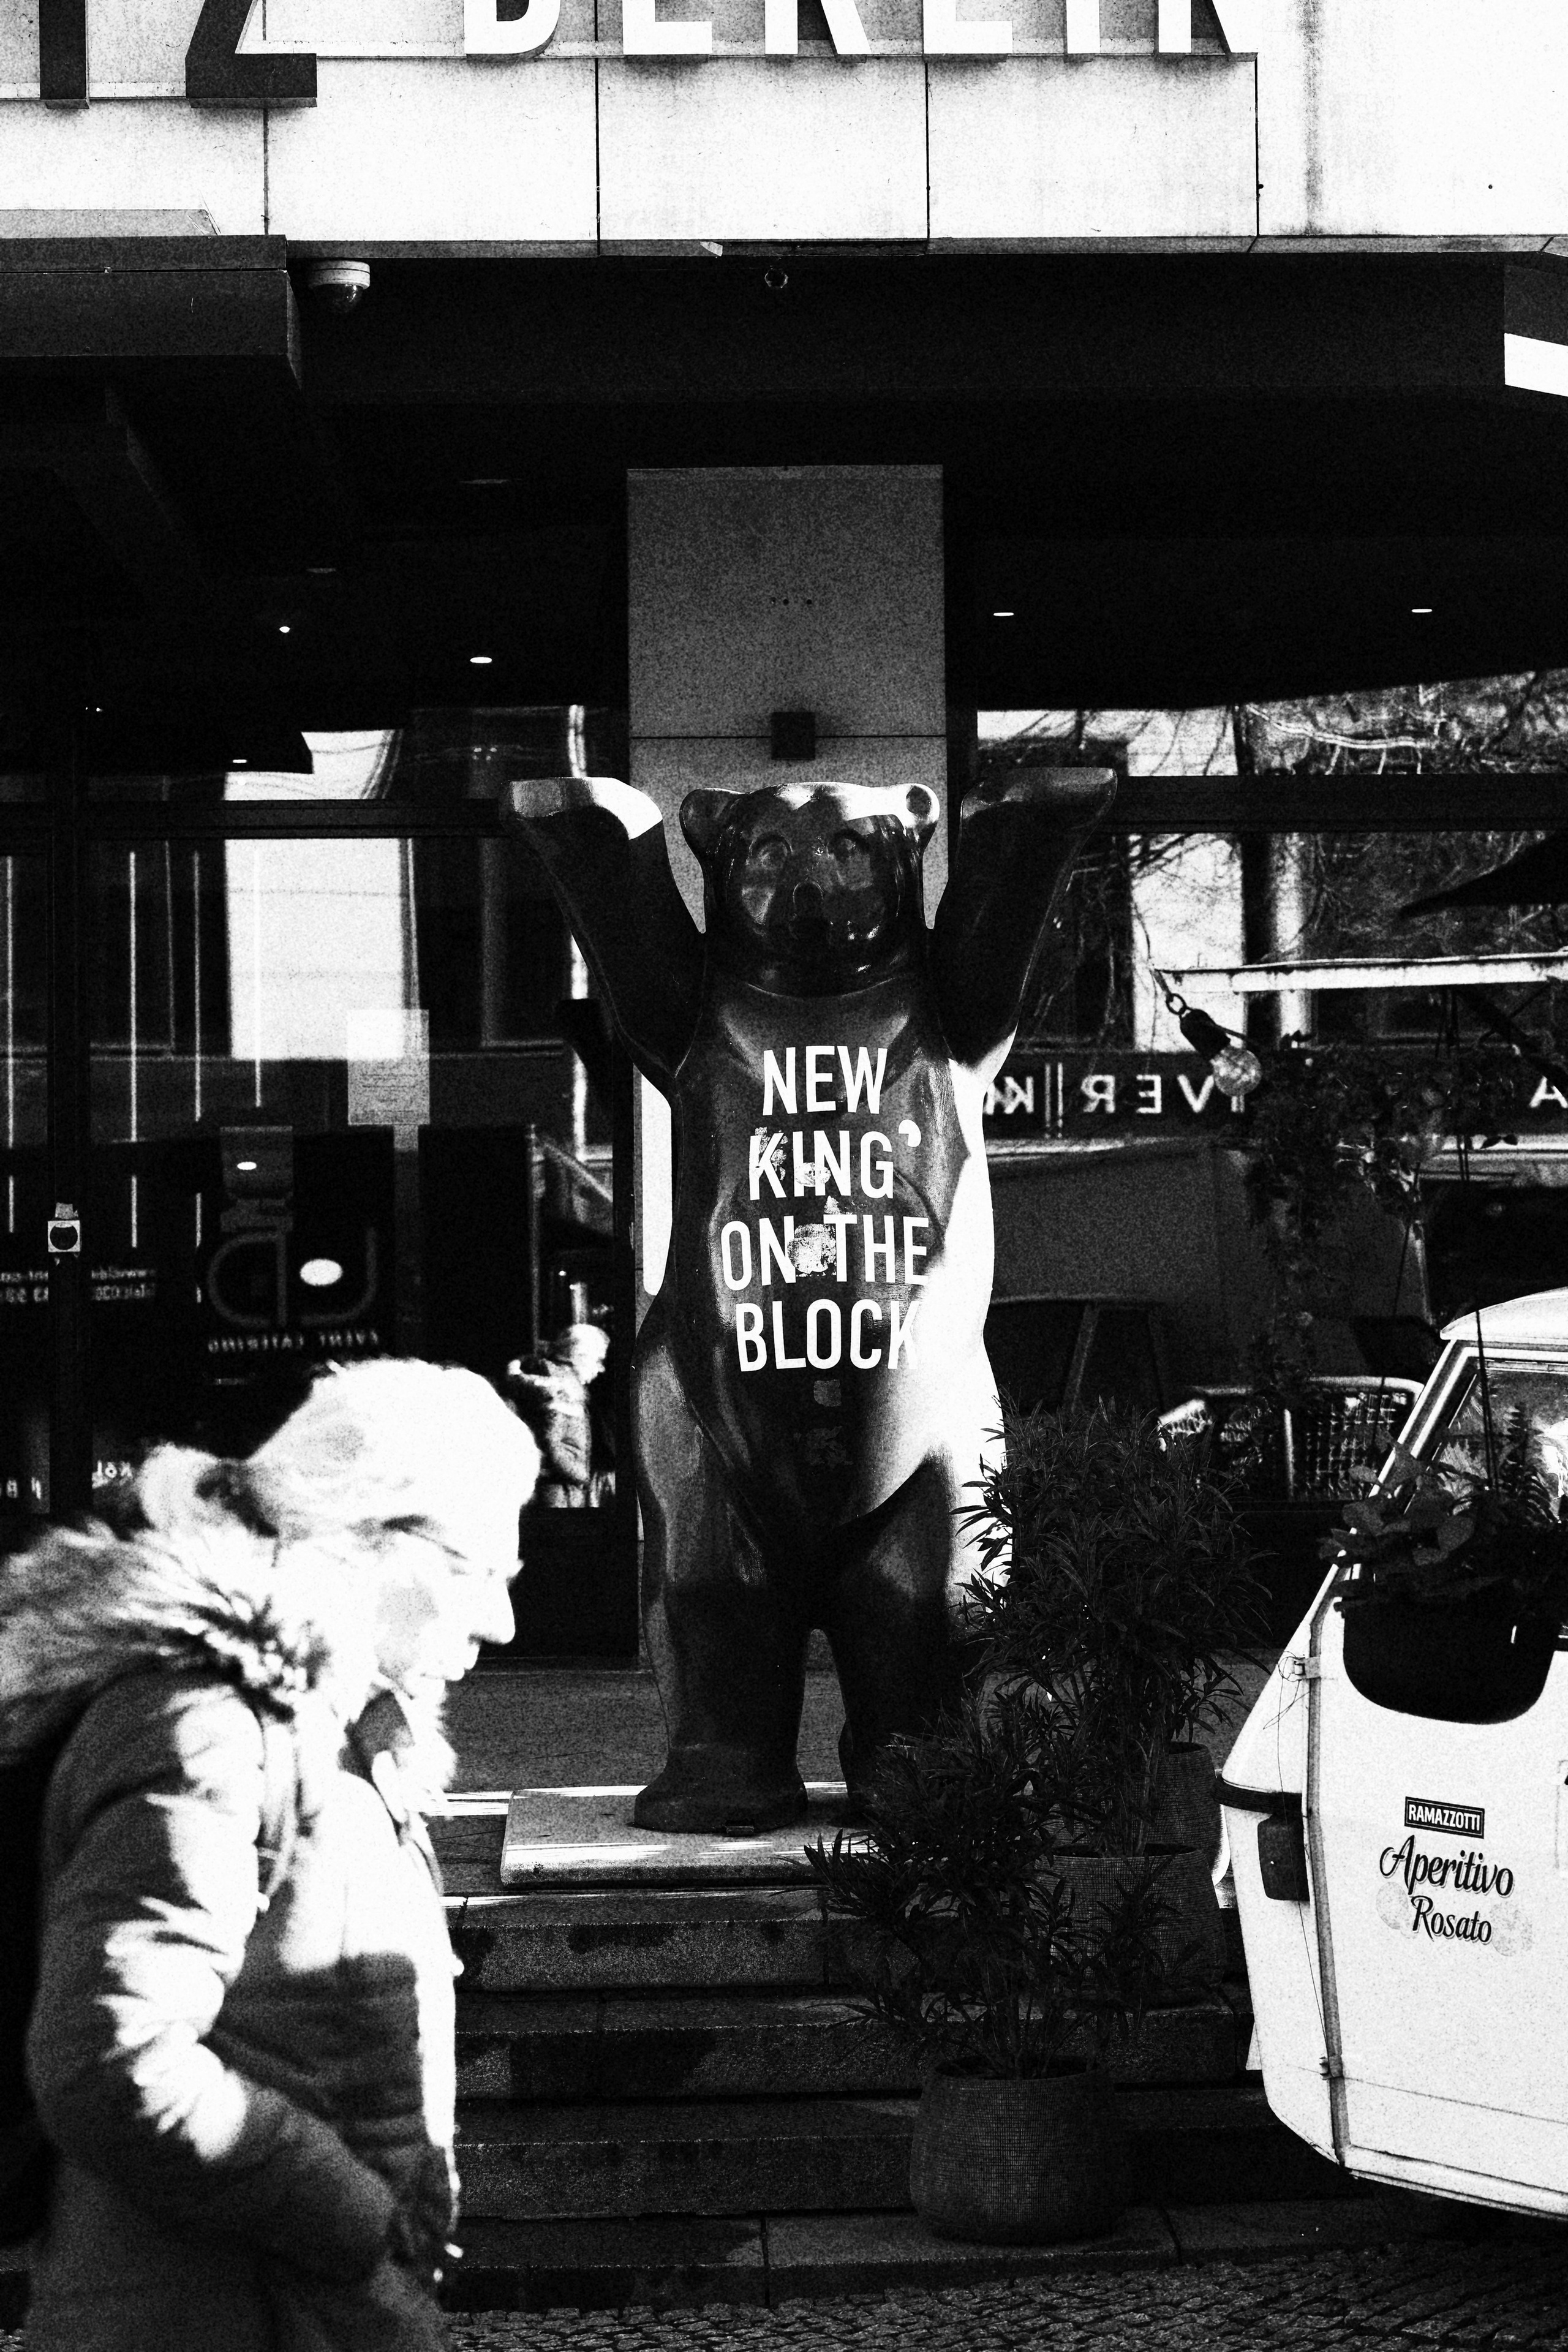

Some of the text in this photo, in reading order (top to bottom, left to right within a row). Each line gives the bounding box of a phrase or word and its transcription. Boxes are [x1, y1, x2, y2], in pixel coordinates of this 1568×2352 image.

[763, 1045, 888, 1115] NEW
[721, 1214, 930, 1291] ON THE
[735, 1298, 921, 1371] BLOCK
[1408, 1804, 1480, 1831] RAMAZZOTTI
[1379, 1834, 1515, 1897] Aperitivo
[1411, 1895, 1493, 1943] Rosato
